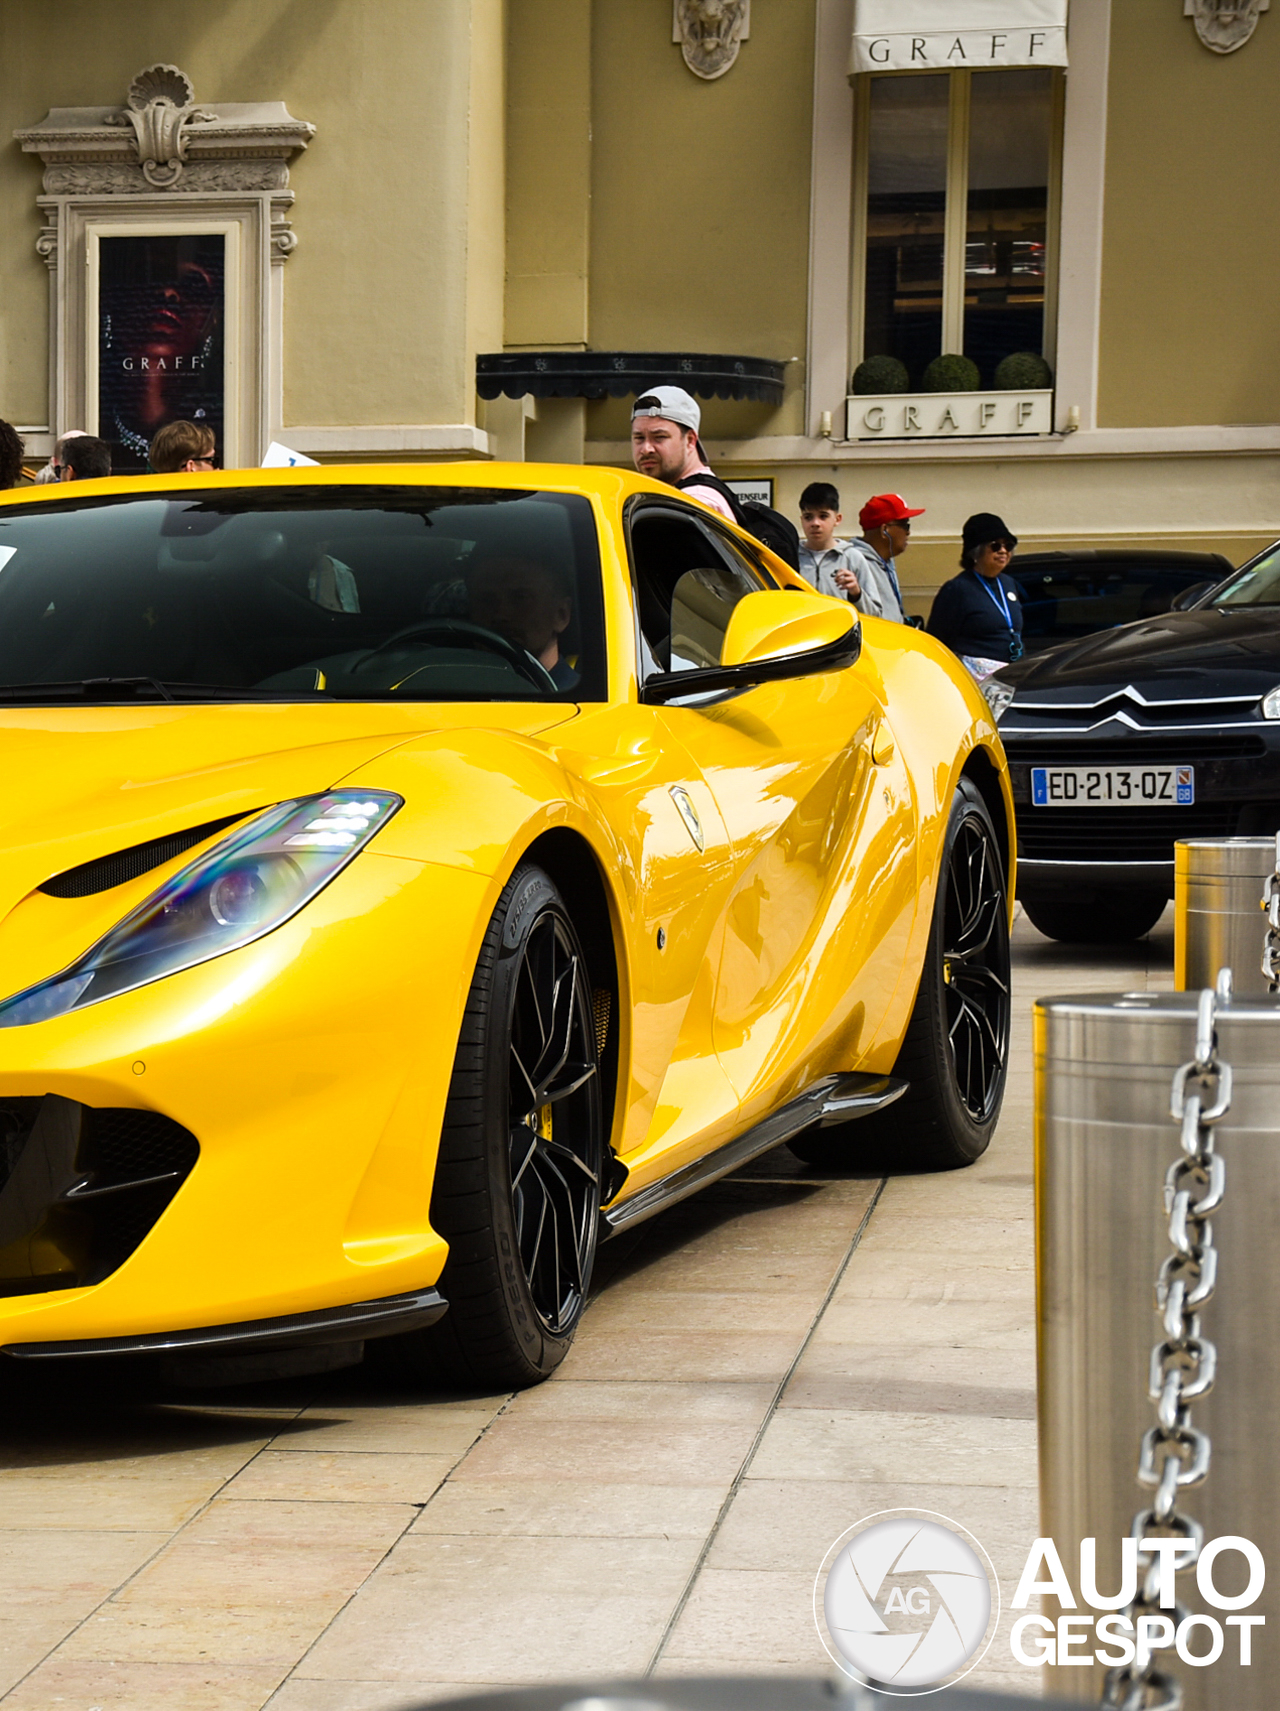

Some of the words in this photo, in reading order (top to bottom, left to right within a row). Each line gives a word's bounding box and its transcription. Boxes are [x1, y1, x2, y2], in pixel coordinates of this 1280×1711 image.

[868, 33, 1046, 62] GRAFF
[122, 356, 200, 370] GRAFF
[863, 402, 1033, 431] GRAFF
[1049, 772, 1173, 800] ED-213-QZ
[1178, 788, 1191, 801] 68
